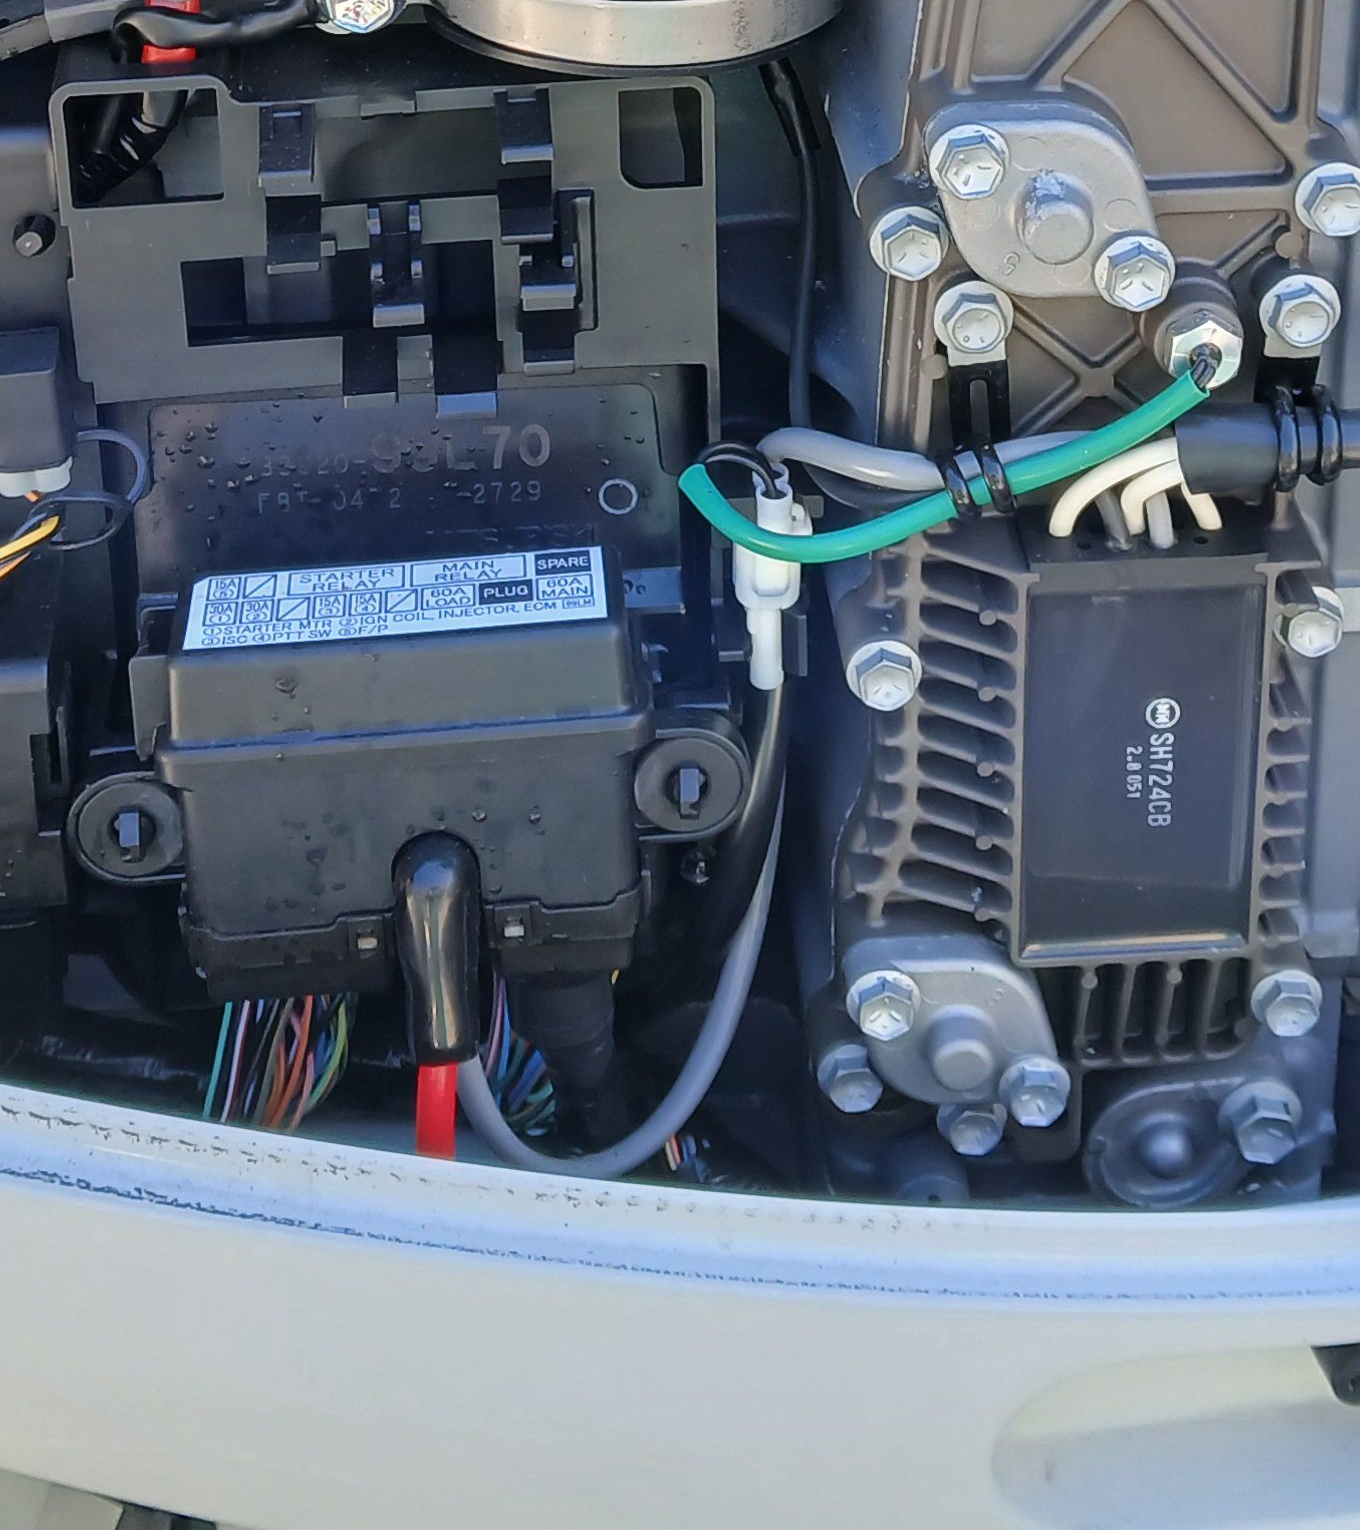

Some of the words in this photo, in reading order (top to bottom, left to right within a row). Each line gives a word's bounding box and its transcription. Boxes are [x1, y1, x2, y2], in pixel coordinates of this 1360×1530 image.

[442, 559, 495, 572] MAIN
[537, 556, 589, 570] SPARE
[299, 568, 395, 584] STARTER
[434, 568, 503, 582] RELAY
[312, 578, 382, 592] RELAY
[546, 576, 583, 588] 60A
[355, 592, 377, 604] 15A
[430, 587, 467, 599] 60A
[483, 585, 528, 599] PLUG
[541, 586, 588, 599] MAIN
[245, 601, 269, 613] 30A
[319, 596, 341, 607] 15A
[425, 596, 471, 609] LOAD
[209, 603, 233, 615] 30A
[300, 619, 332, 631] MTR
[439, 604, 521, 620] INJECTOR,
[524, 601, 557, 612] ECM
[308, 628, 332, 639] SW
[1147, 732, 1175, 827] SH724CB
